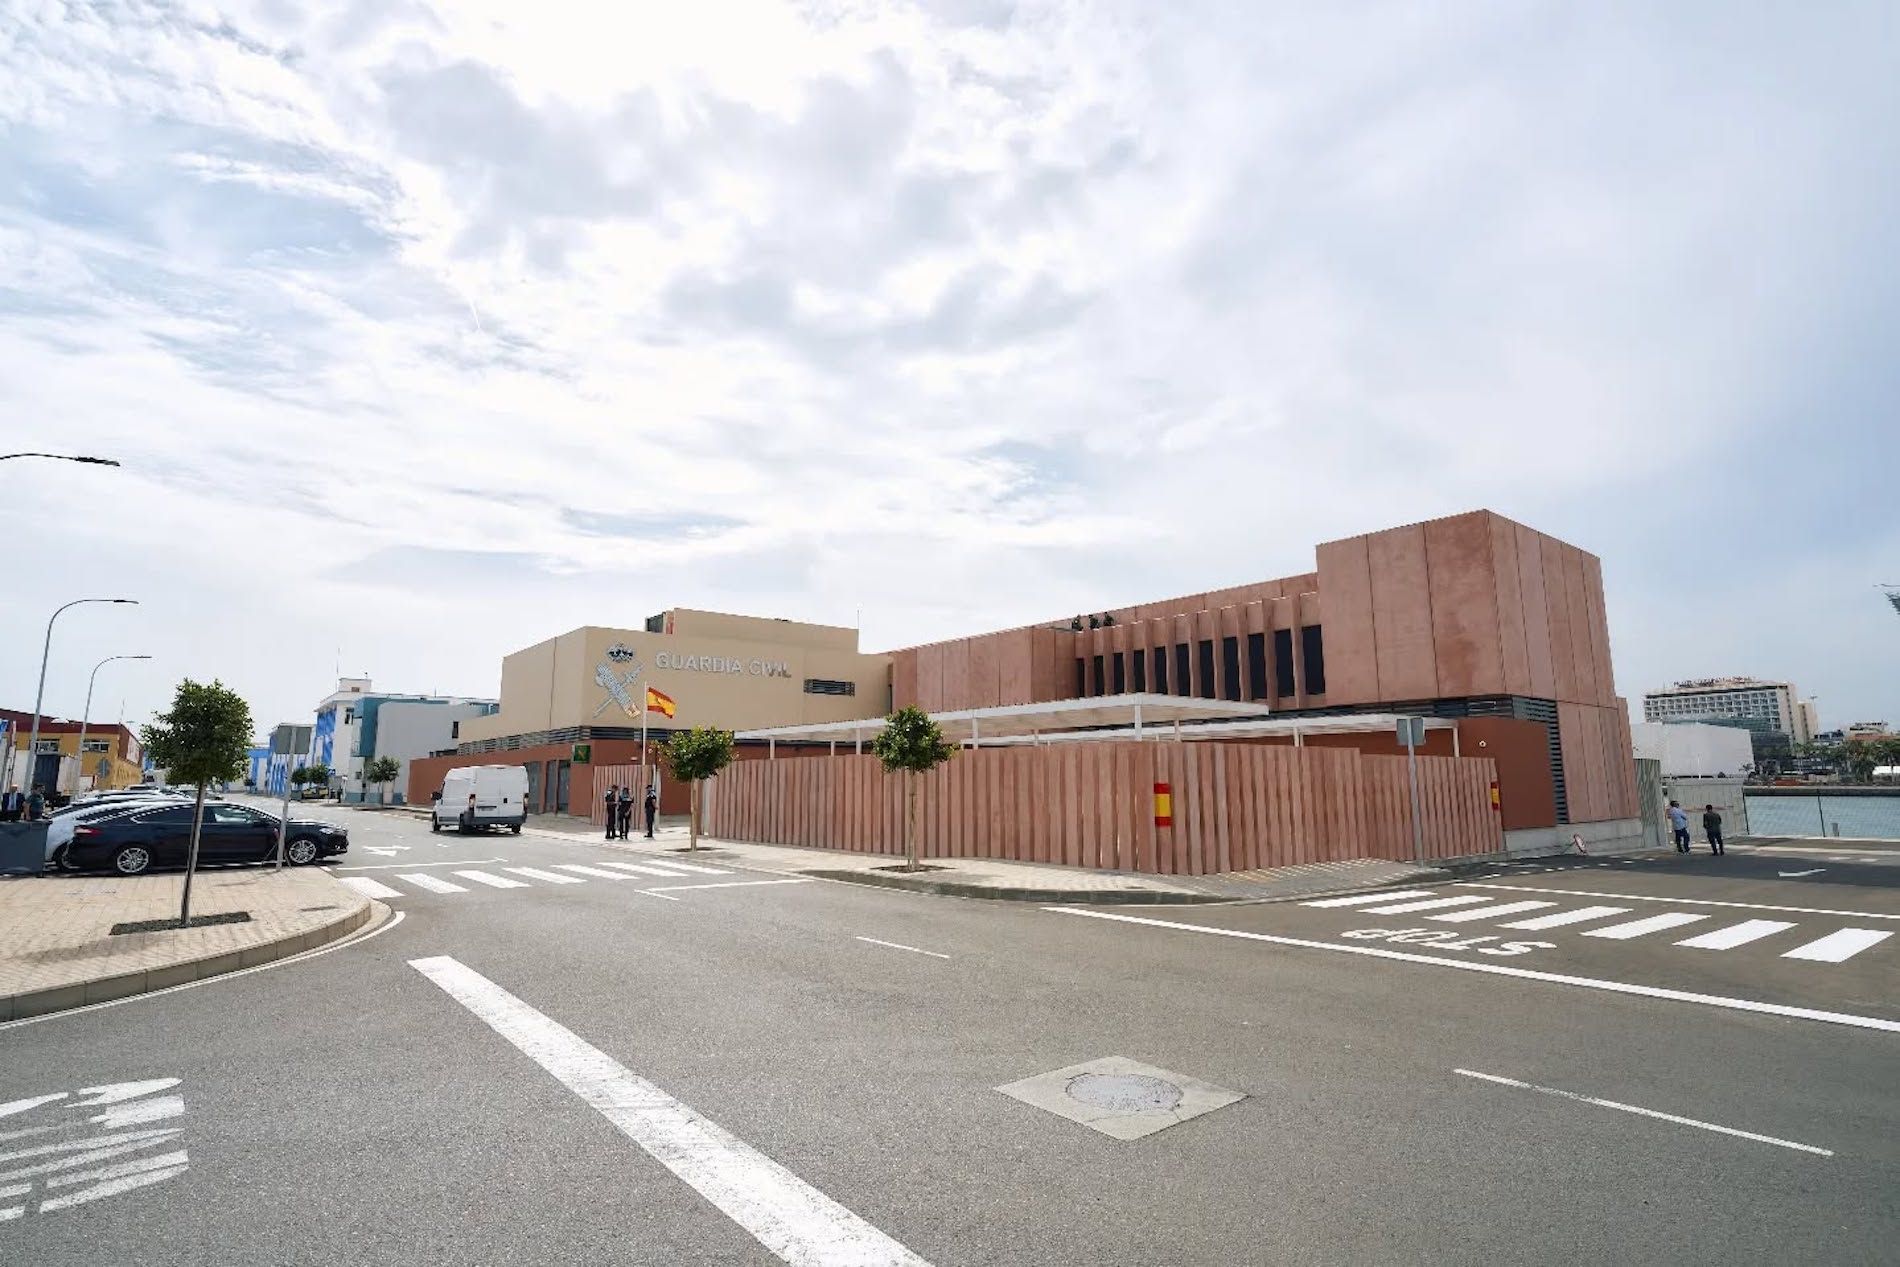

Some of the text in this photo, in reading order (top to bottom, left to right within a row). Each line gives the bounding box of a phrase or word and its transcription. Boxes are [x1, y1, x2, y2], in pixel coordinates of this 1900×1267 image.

[655, 650, 792, 678] GUARDIA CIVIL
[1340, 928, 1557, 955] STOP
